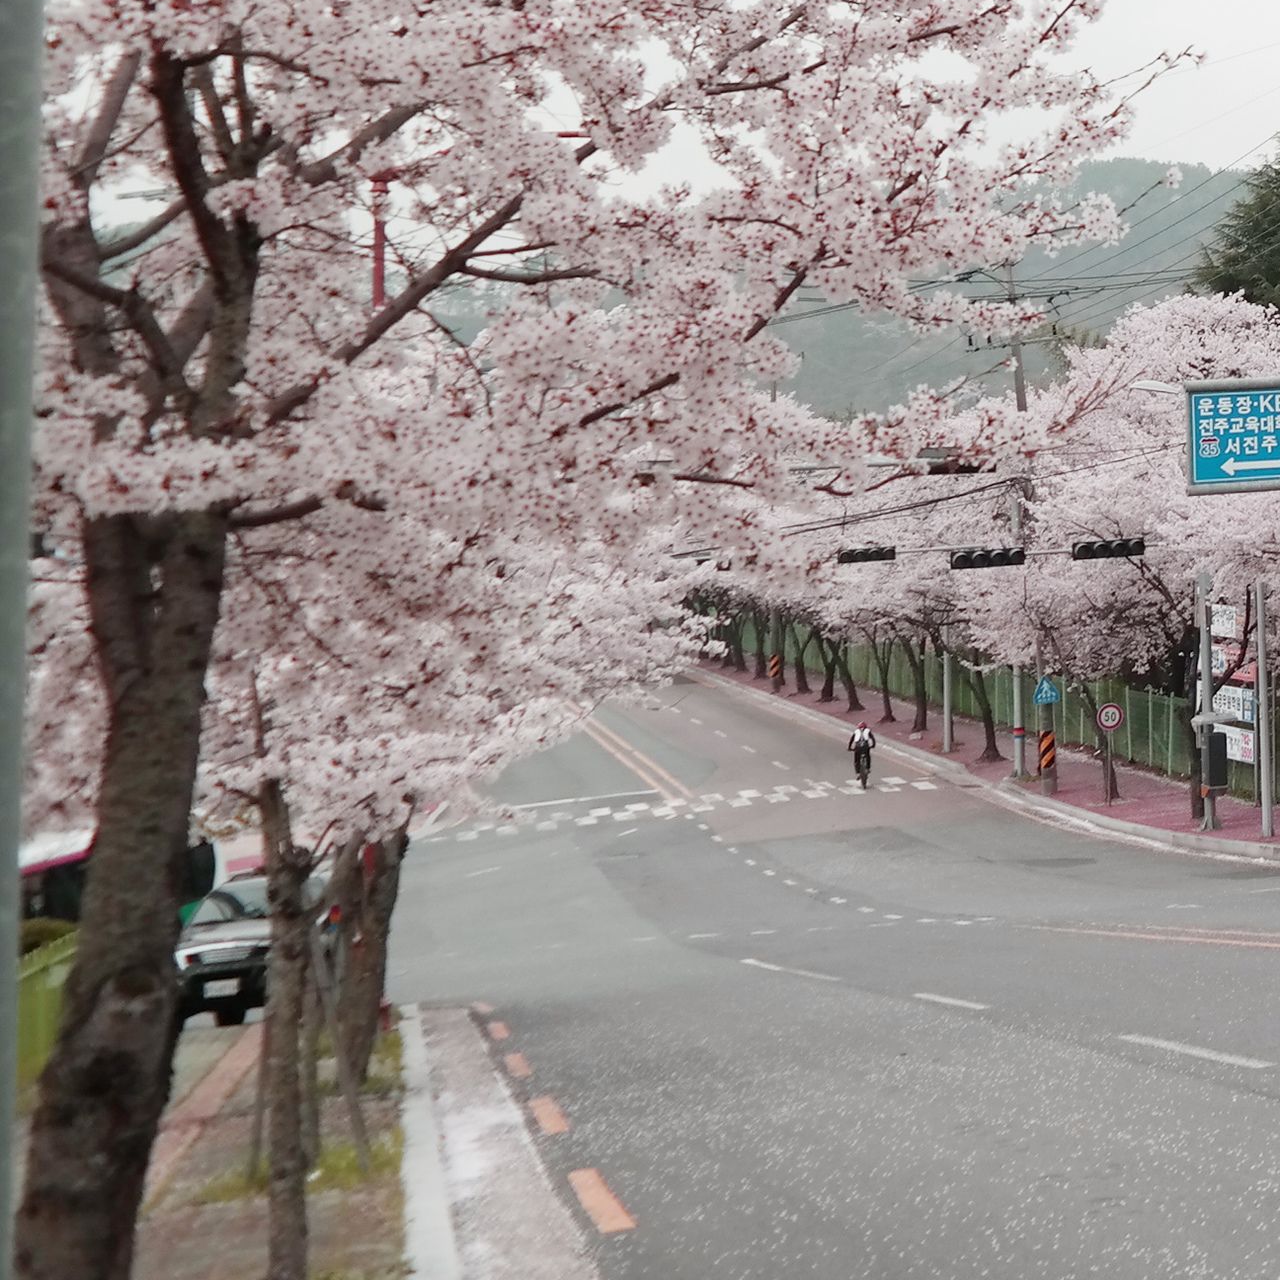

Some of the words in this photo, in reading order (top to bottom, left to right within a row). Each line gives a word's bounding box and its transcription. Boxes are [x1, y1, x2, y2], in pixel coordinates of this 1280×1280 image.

[1202, 443, 1217, 455] 35
[1224, 435, 1278, 455] 서진주
[1104, 711, 1117, 722] 50
